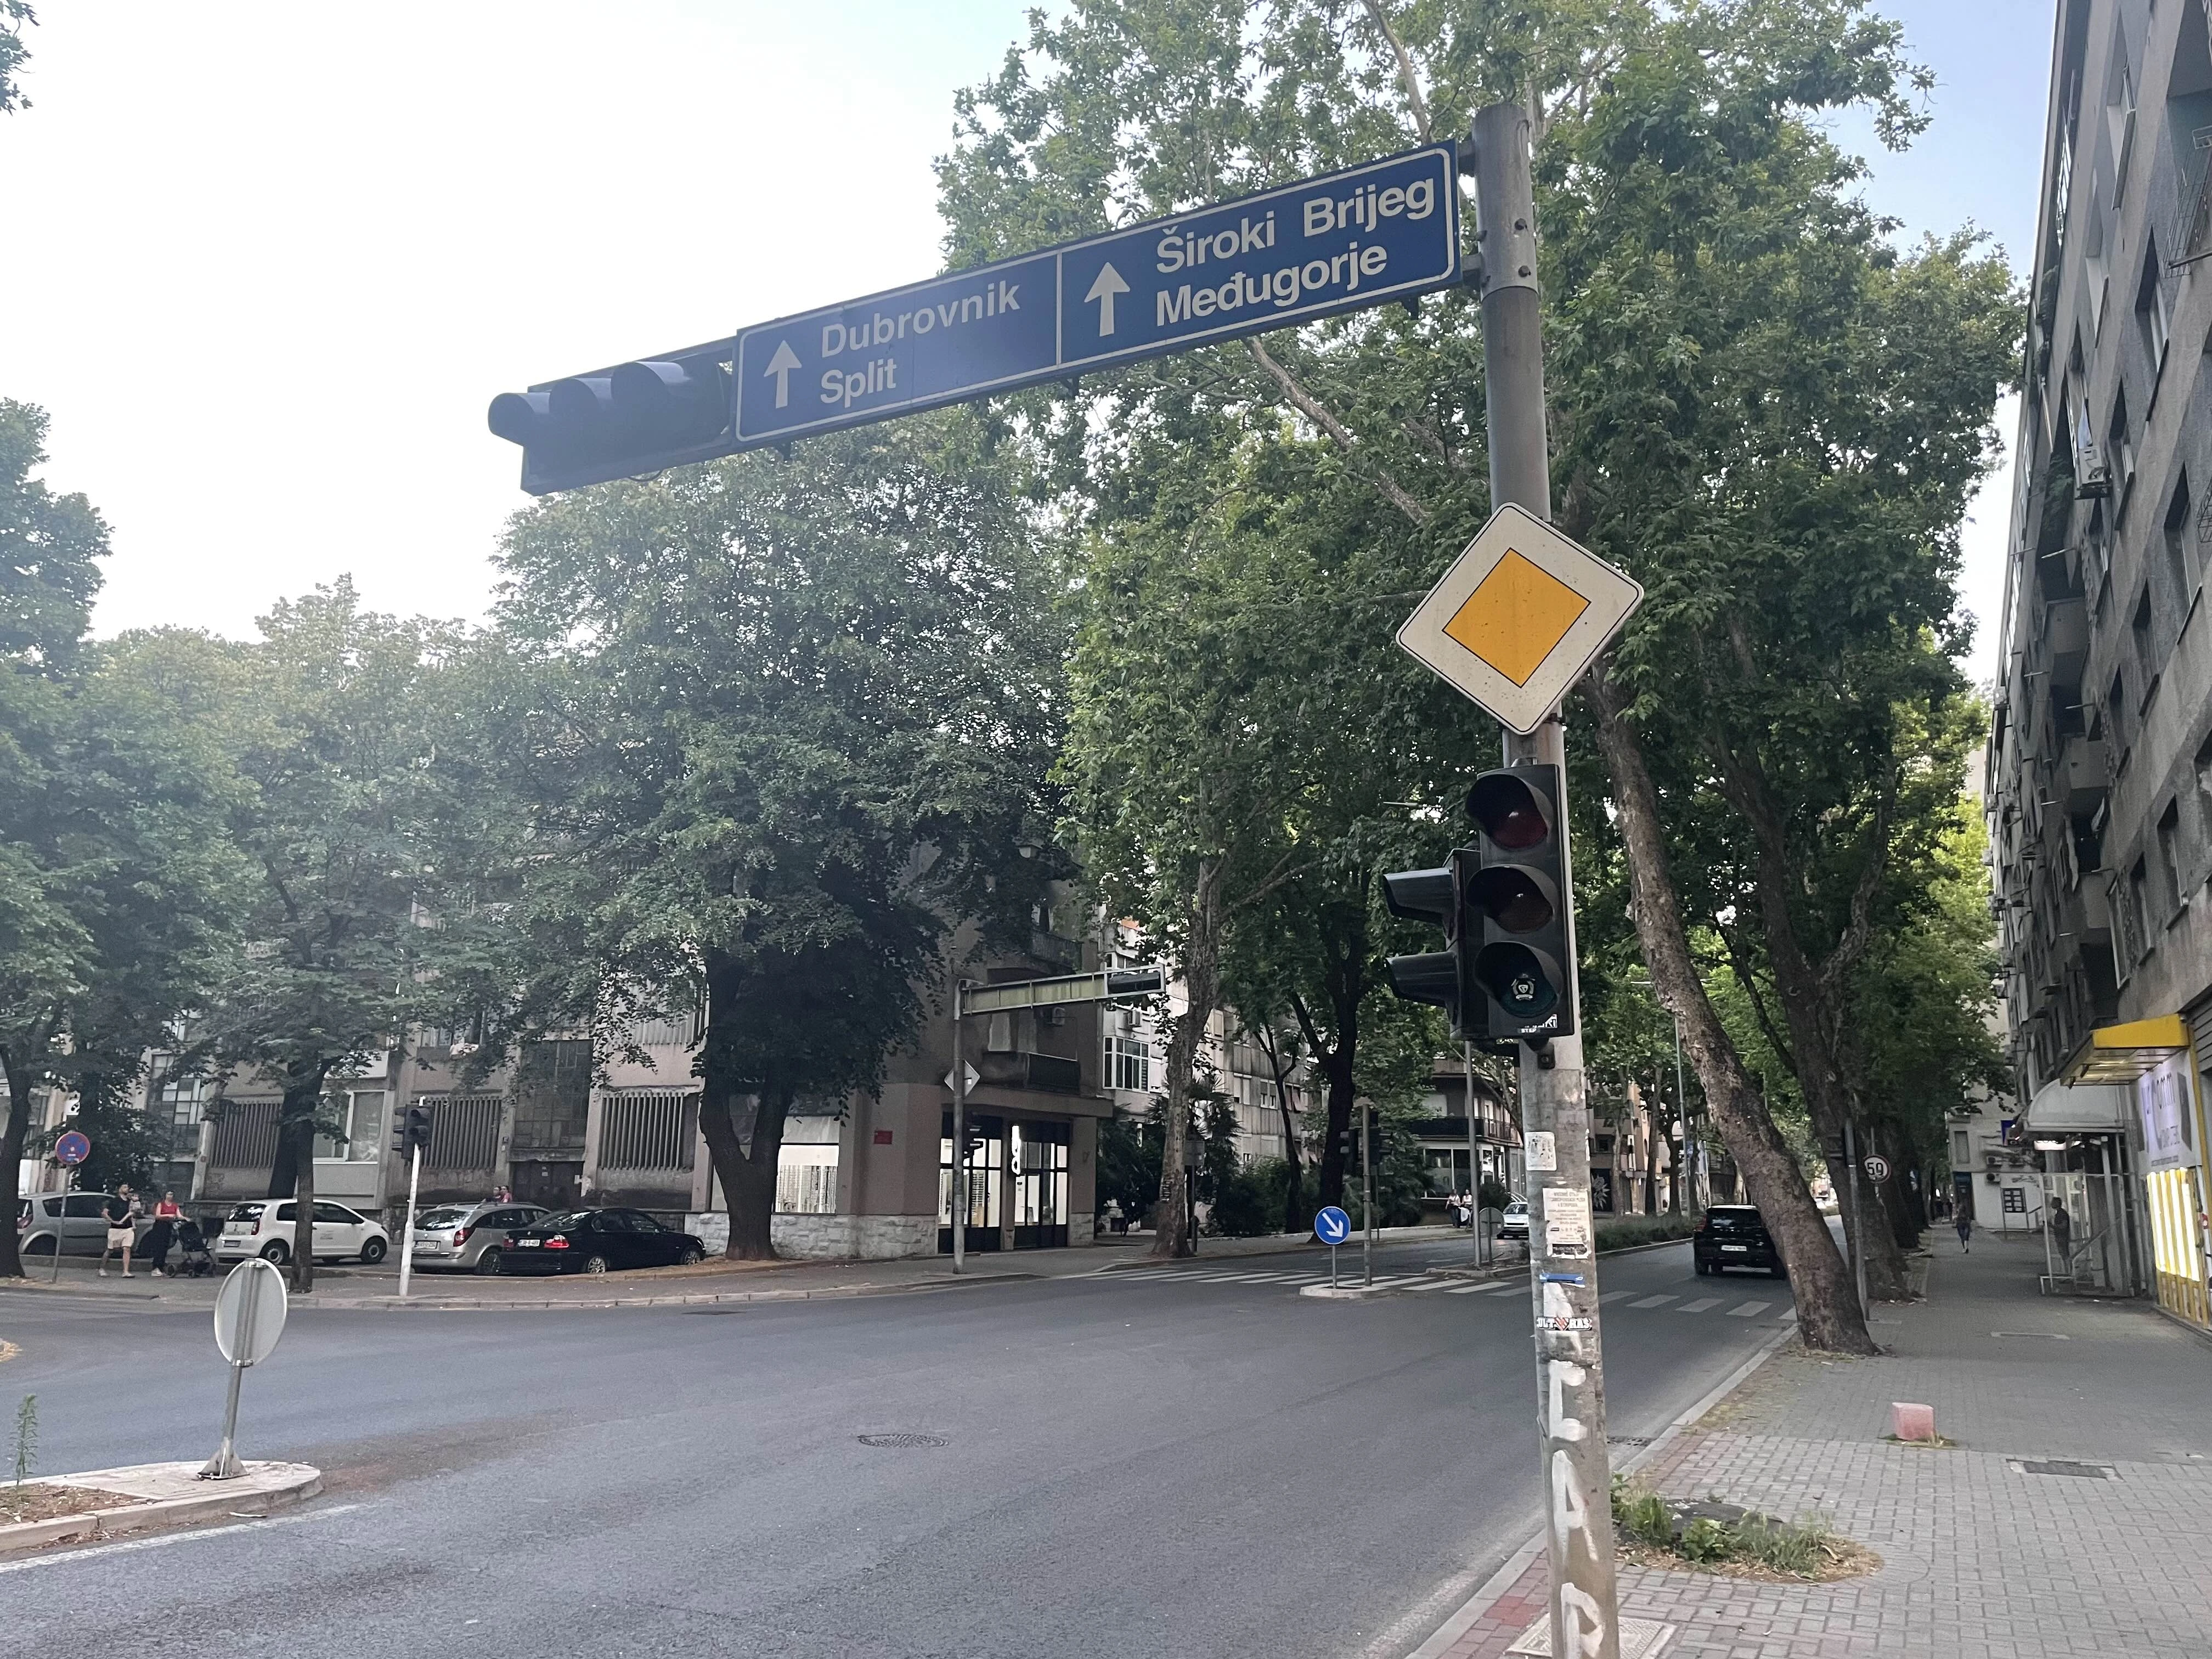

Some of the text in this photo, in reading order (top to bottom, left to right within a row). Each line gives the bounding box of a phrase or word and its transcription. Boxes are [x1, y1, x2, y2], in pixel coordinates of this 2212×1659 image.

[1156, 178, 1435, 273] Široki Brijeg
[822, 280, 1020, 358] Dubrovnik
[1157, 241, 1387, 326] Međugorje
[820, 358, 897, 408] Split
[1867, 1162, 1884, 1176] 50
